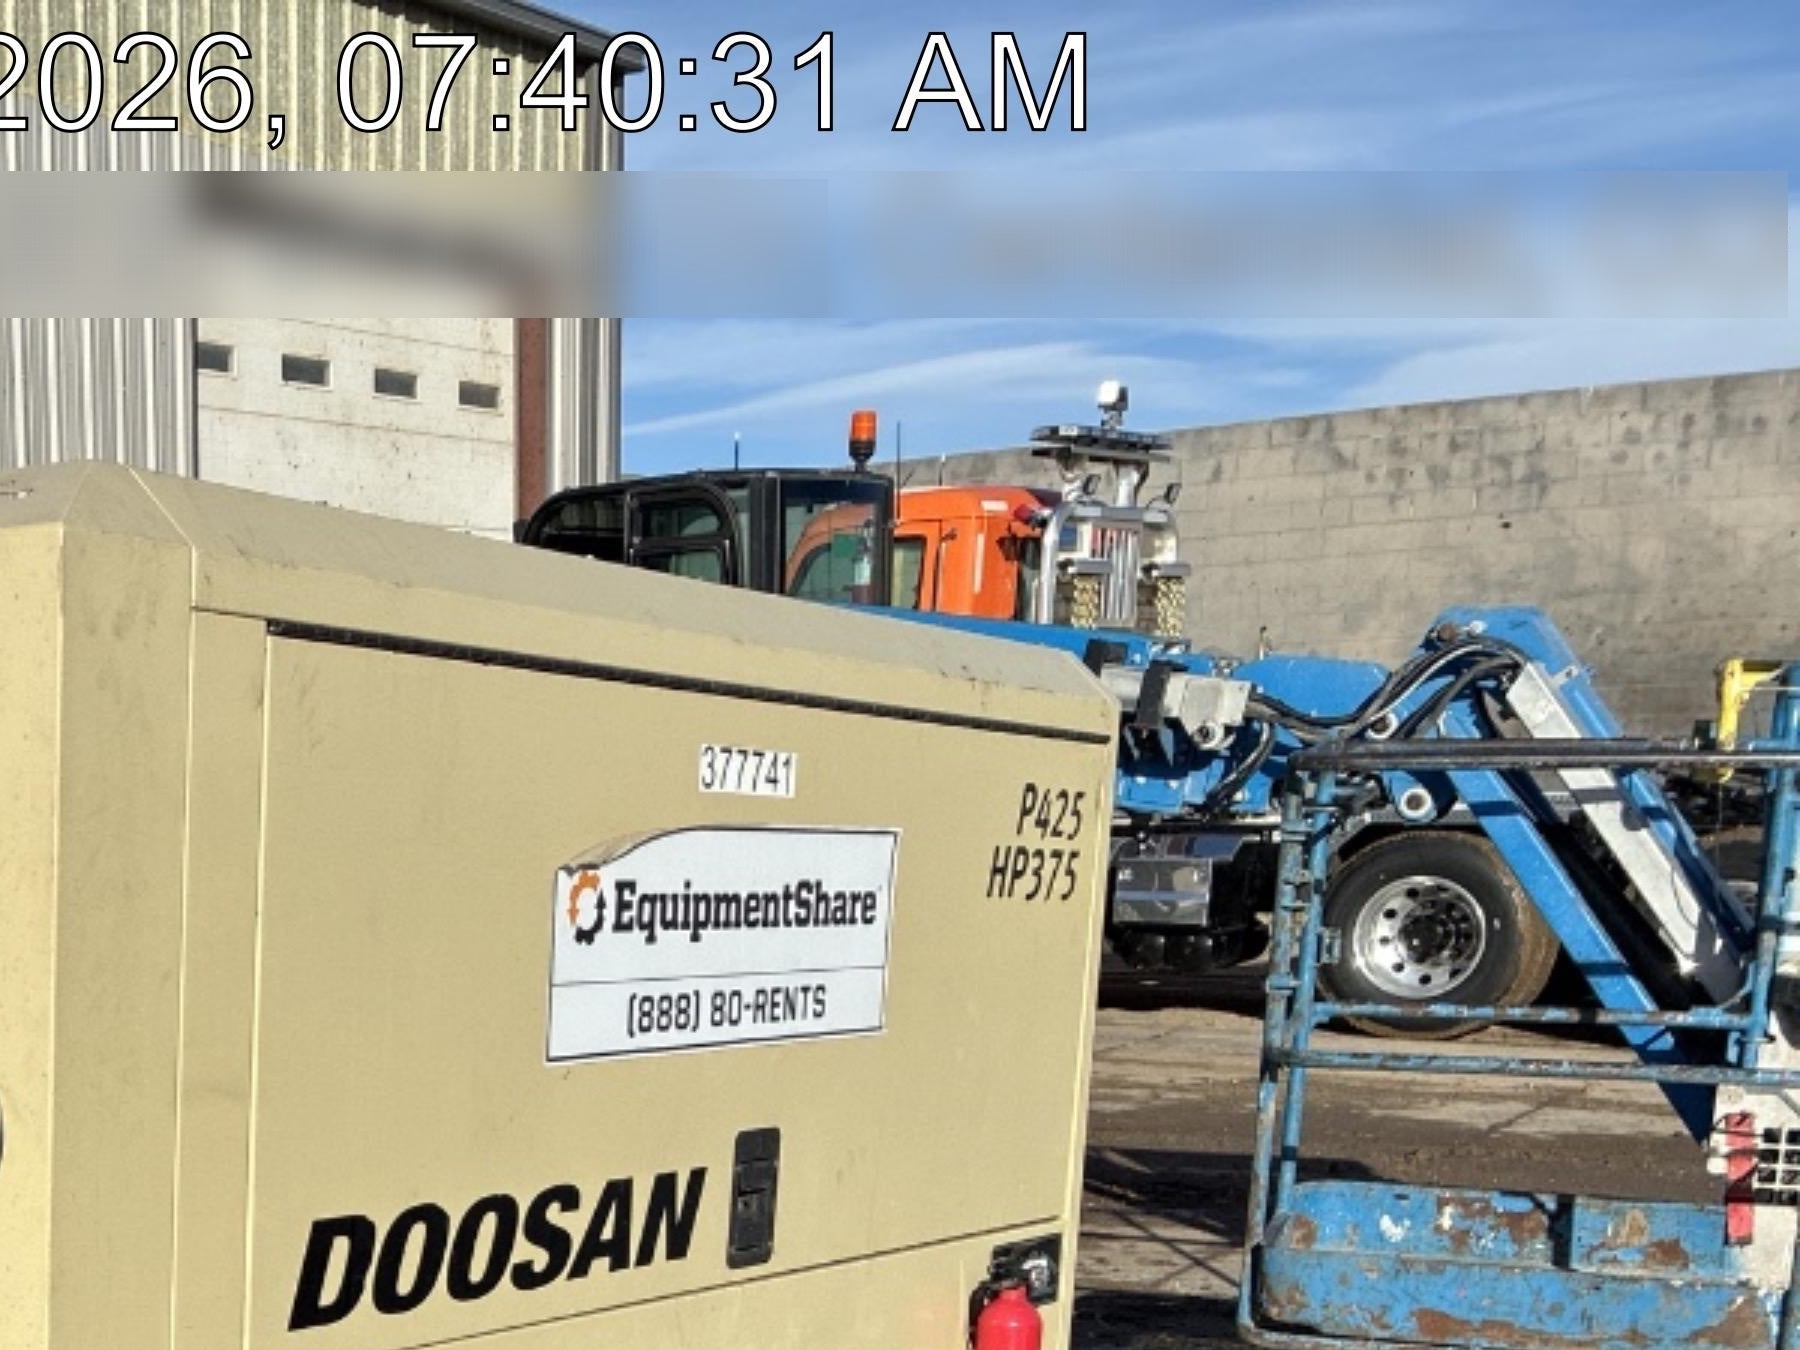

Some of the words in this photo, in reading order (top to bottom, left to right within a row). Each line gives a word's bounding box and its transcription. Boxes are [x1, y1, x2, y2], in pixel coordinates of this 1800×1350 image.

[700, 745, 795, 796] 377741
[1016, 782, 1086, 841] P425
[986, 845, 1080, 901] HP375
[611, 880, 877, 944] EquipmentShare
[627, 992, 700, 1038] (888)
[710, 985, 826, 1028] 80-RENTS
[287, 1166, 708, 1332] DOOSAN
